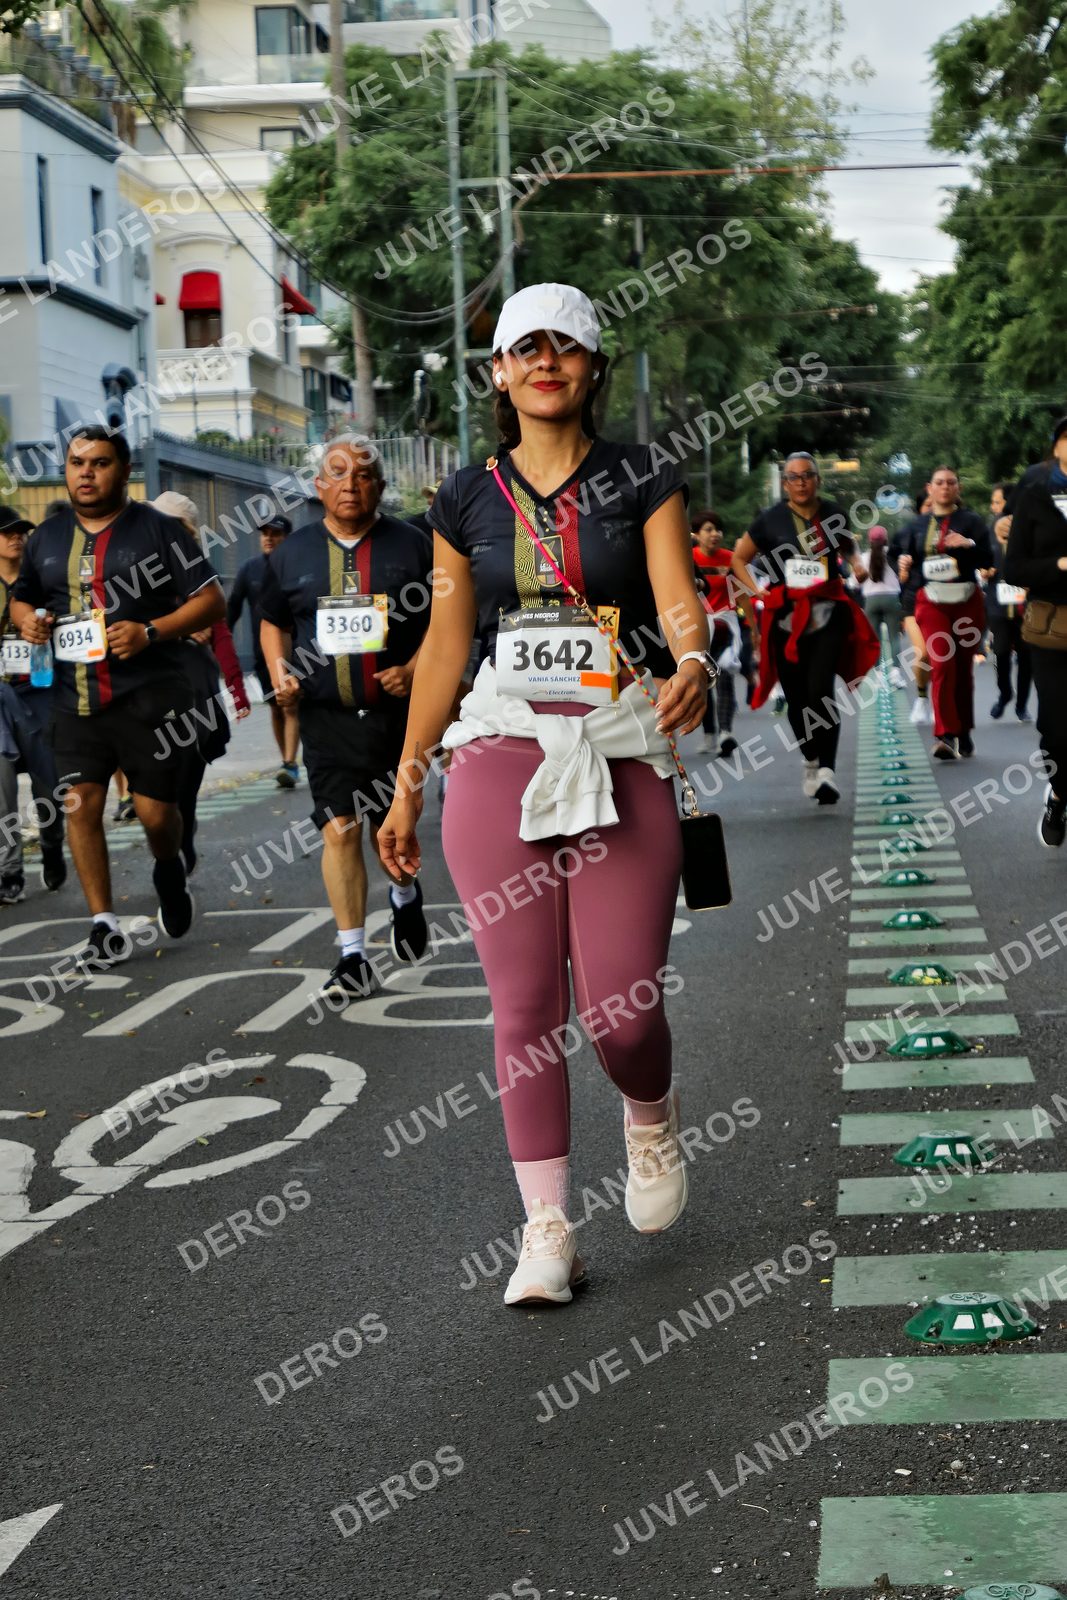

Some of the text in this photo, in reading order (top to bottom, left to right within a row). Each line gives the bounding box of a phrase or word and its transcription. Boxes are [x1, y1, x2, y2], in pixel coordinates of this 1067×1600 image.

[326, 615, 372, 634] 3360
[513, 613, 533, 622] LENES
[600, 615, 614, 626] 5K
[59, 628, 93, 648] 6934
[513, 639, 594, 671] 3642
